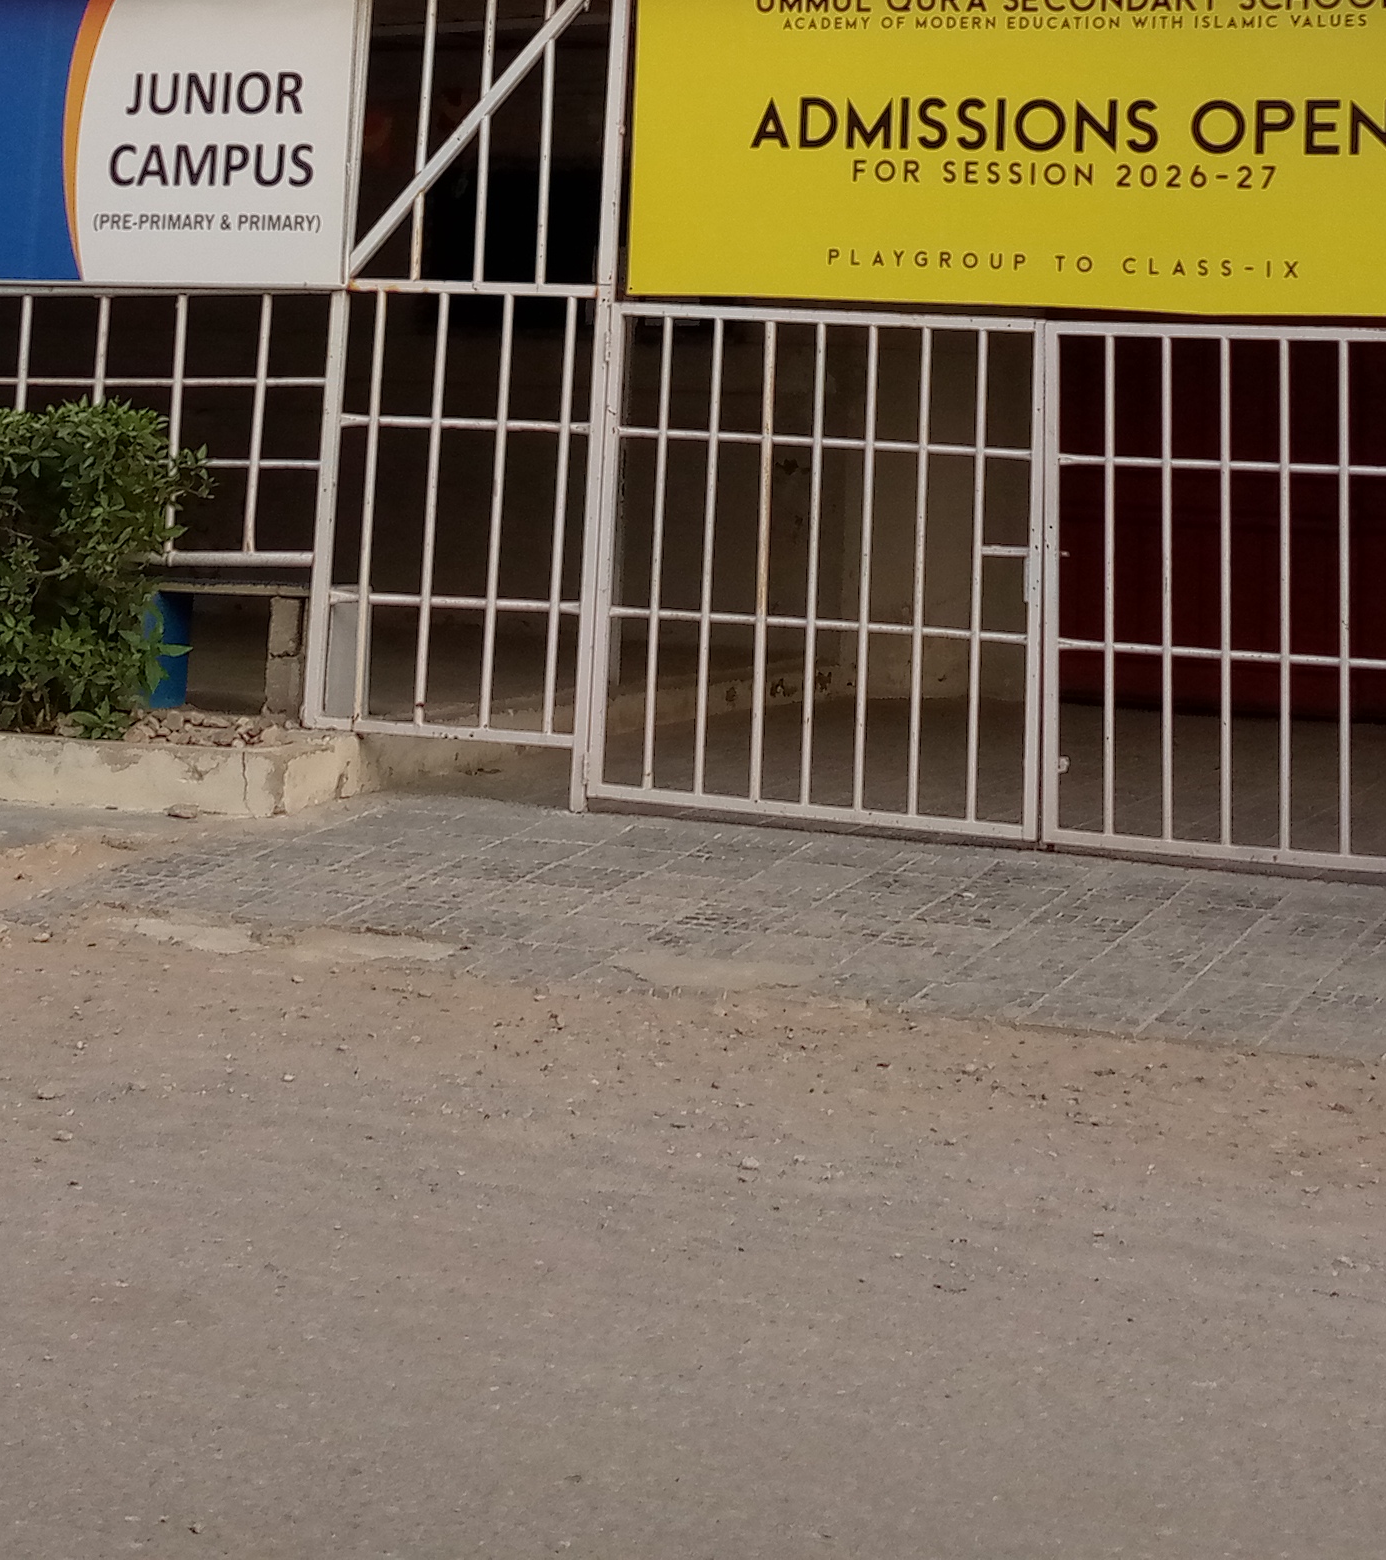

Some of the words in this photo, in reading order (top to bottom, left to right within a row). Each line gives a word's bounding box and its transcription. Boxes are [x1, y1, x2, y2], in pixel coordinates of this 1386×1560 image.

[783, 16, 870, 30] ACADEMY
[881, 16, 905, 29] OF
[915, 16, 996, 30] MODERN
[1007, 16, 1120, 30] EDUCATION
[1132, 15, 1183, 29] WITH
[1194, 15, 1277, 29] ISLAMIC
[1290, 13, 1367, 28] VALUES
[125, 71, 303, 116] JUNIOR
[750, 96, 1159, 154] ADMISSIONS
[109, 143, 314, 188] CAMPUS
[852, 159, 921, 184] FOR
[943, 160, 1093, 186] SESSION
[1116, 164, 1276, 189] 2026-27
[93, 214, 215, 231] (PRE-PRIMARY
[220, 214, 231, 231] &
[238, 214, 321, 233] PRIMARY)
[828, 248, 1026, 270] PLAYGROUP
[1055, 255, 1093, 273] TO
[1122, 257, 1298, 278] CLASS-IX
